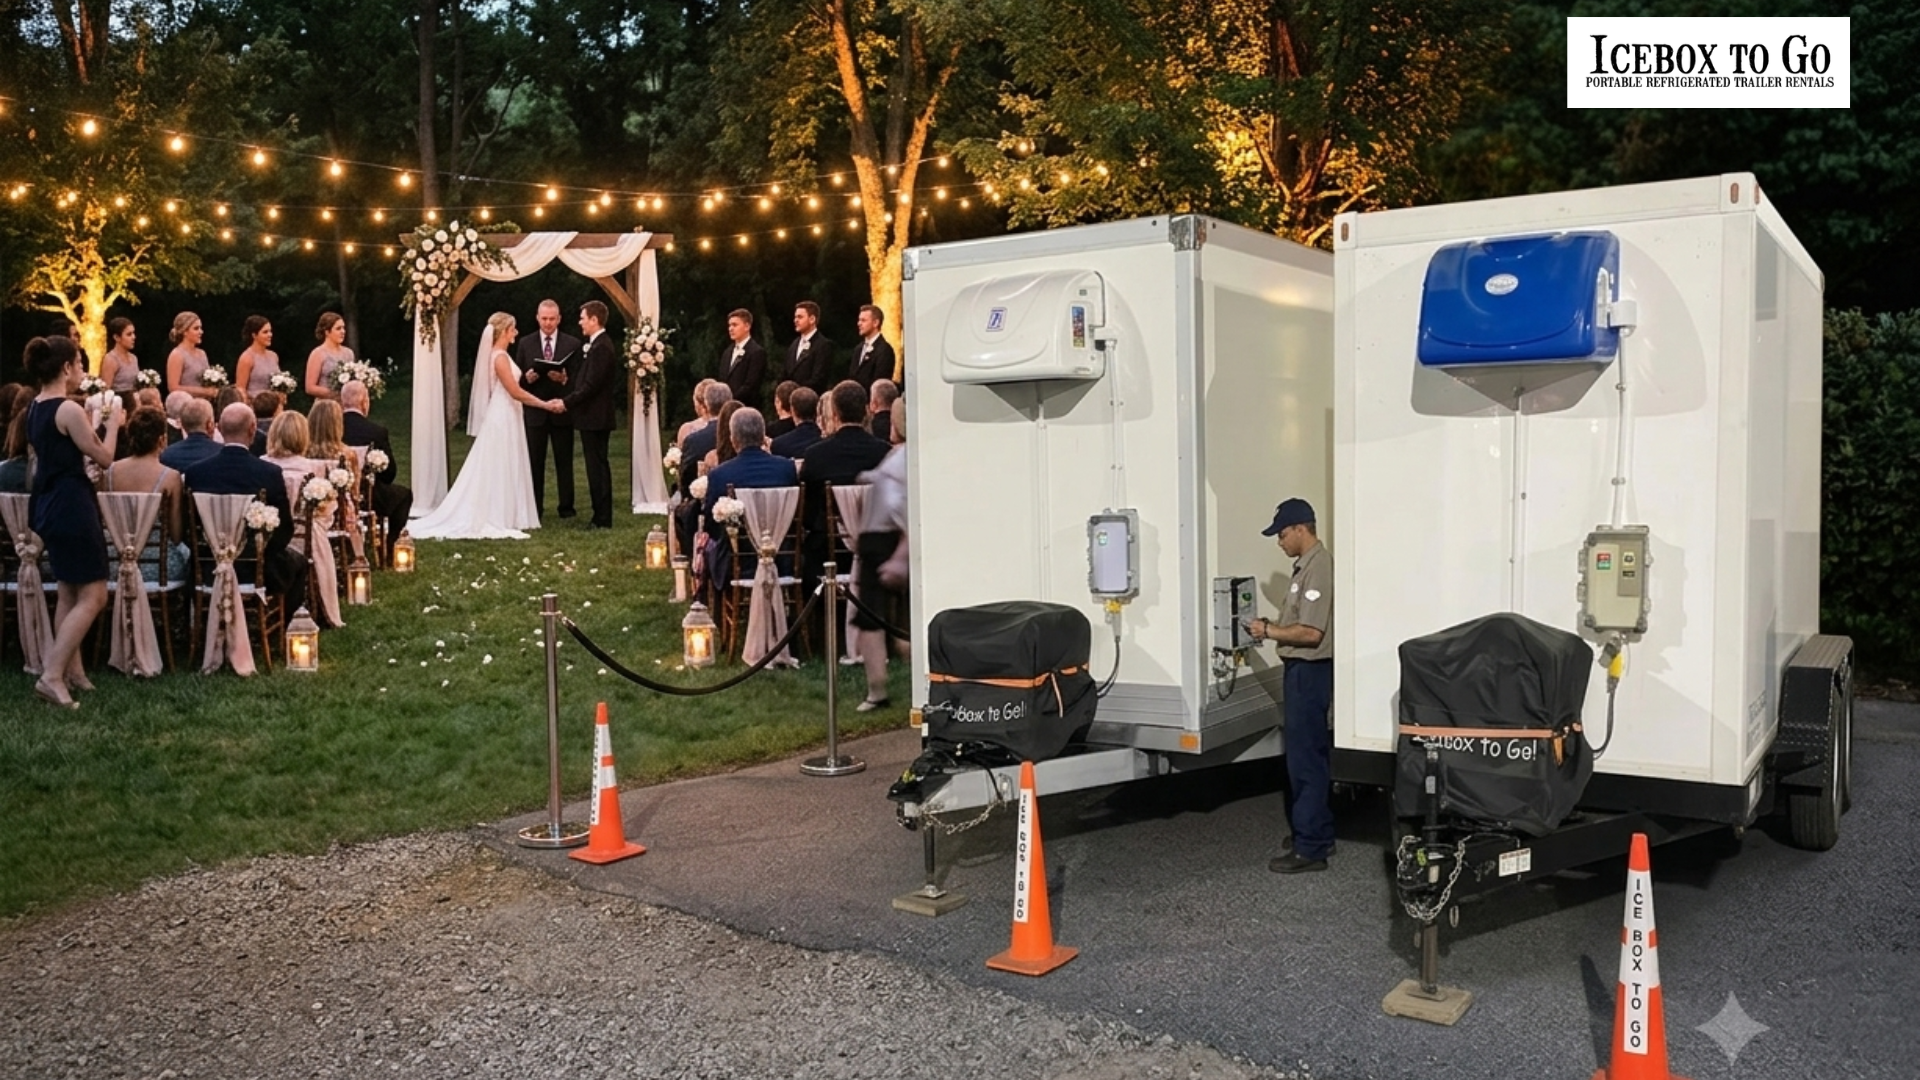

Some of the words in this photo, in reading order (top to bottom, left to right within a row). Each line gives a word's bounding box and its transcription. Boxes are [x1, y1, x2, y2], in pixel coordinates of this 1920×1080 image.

[1633, 879, 1643, 920] ICE
[1632, 930, 1643, 972] BOX
[1631, 983, 1641, 1010] TO
[1630, 1021, 1641, 1048] GO
